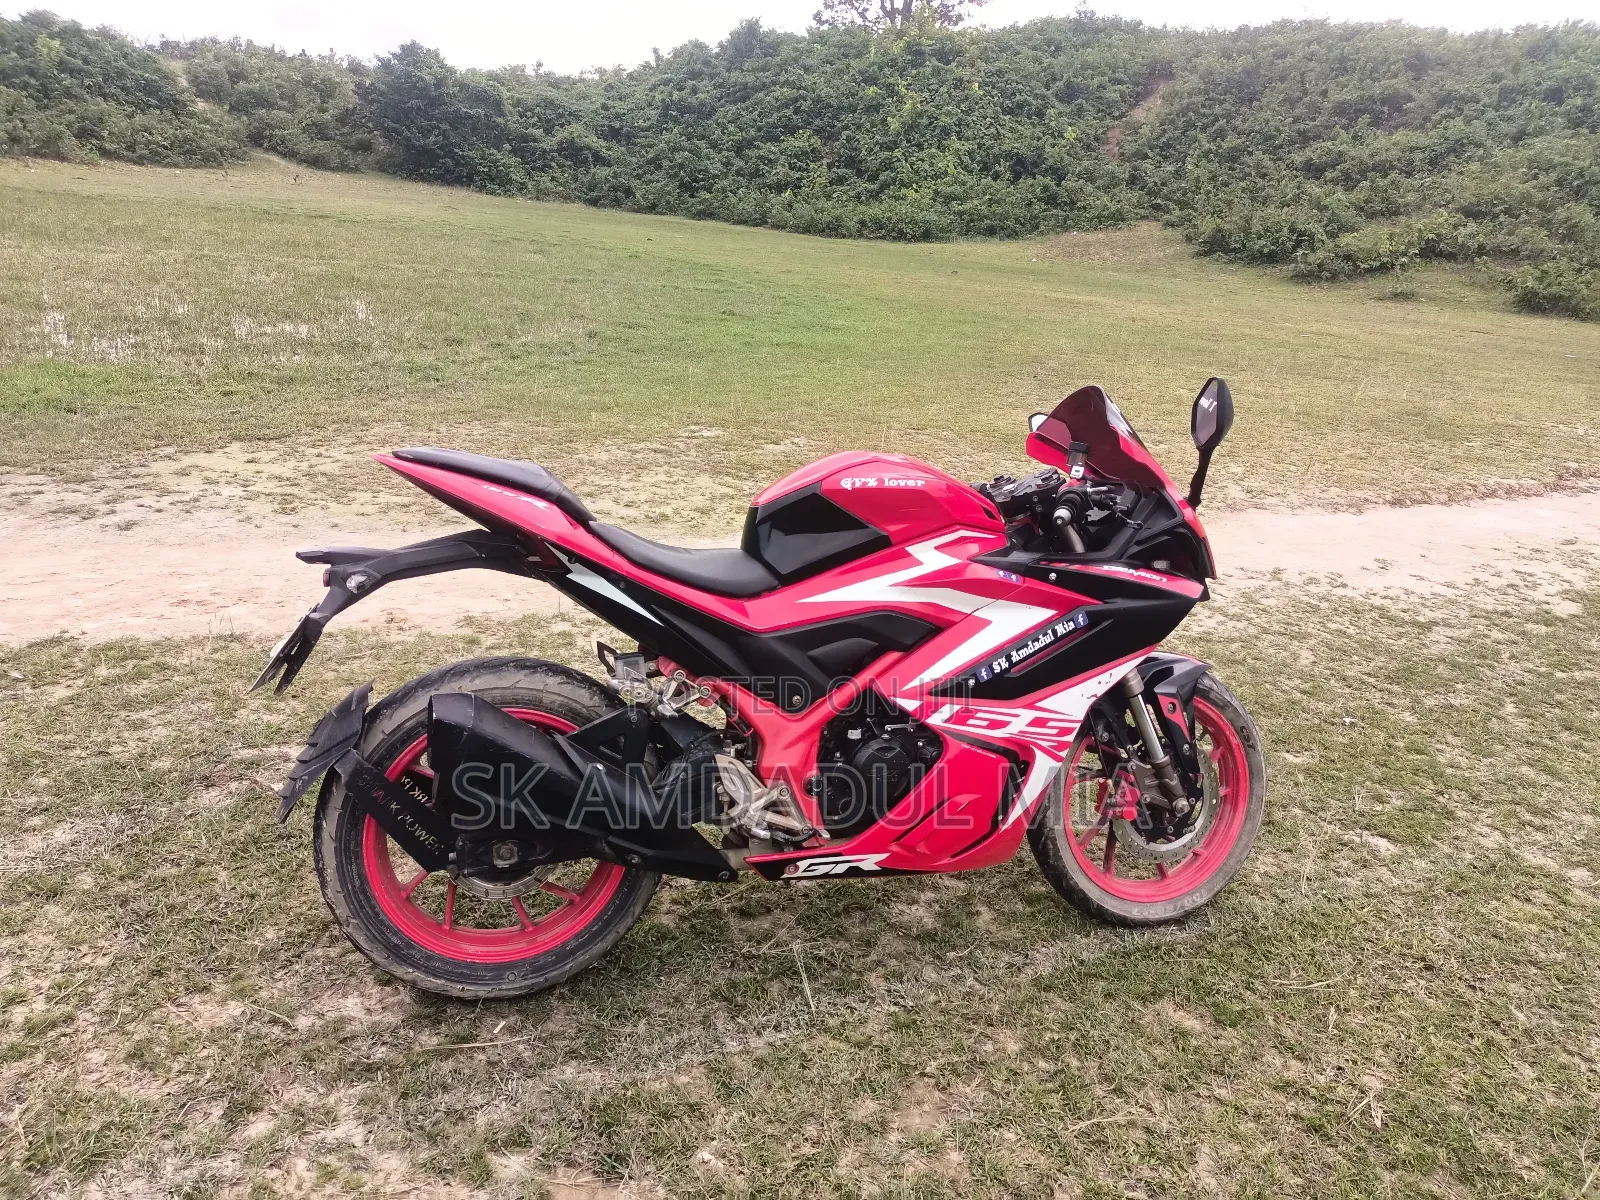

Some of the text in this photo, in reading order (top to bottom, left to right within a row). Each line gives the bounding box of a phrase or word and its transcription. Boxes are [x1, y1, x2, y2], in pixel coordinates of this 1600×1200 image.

[883, 477, 925, 487] lover
[1011, 629, 1055, 663] Amdadul
[1055, 620, 1075, 637] Mia
